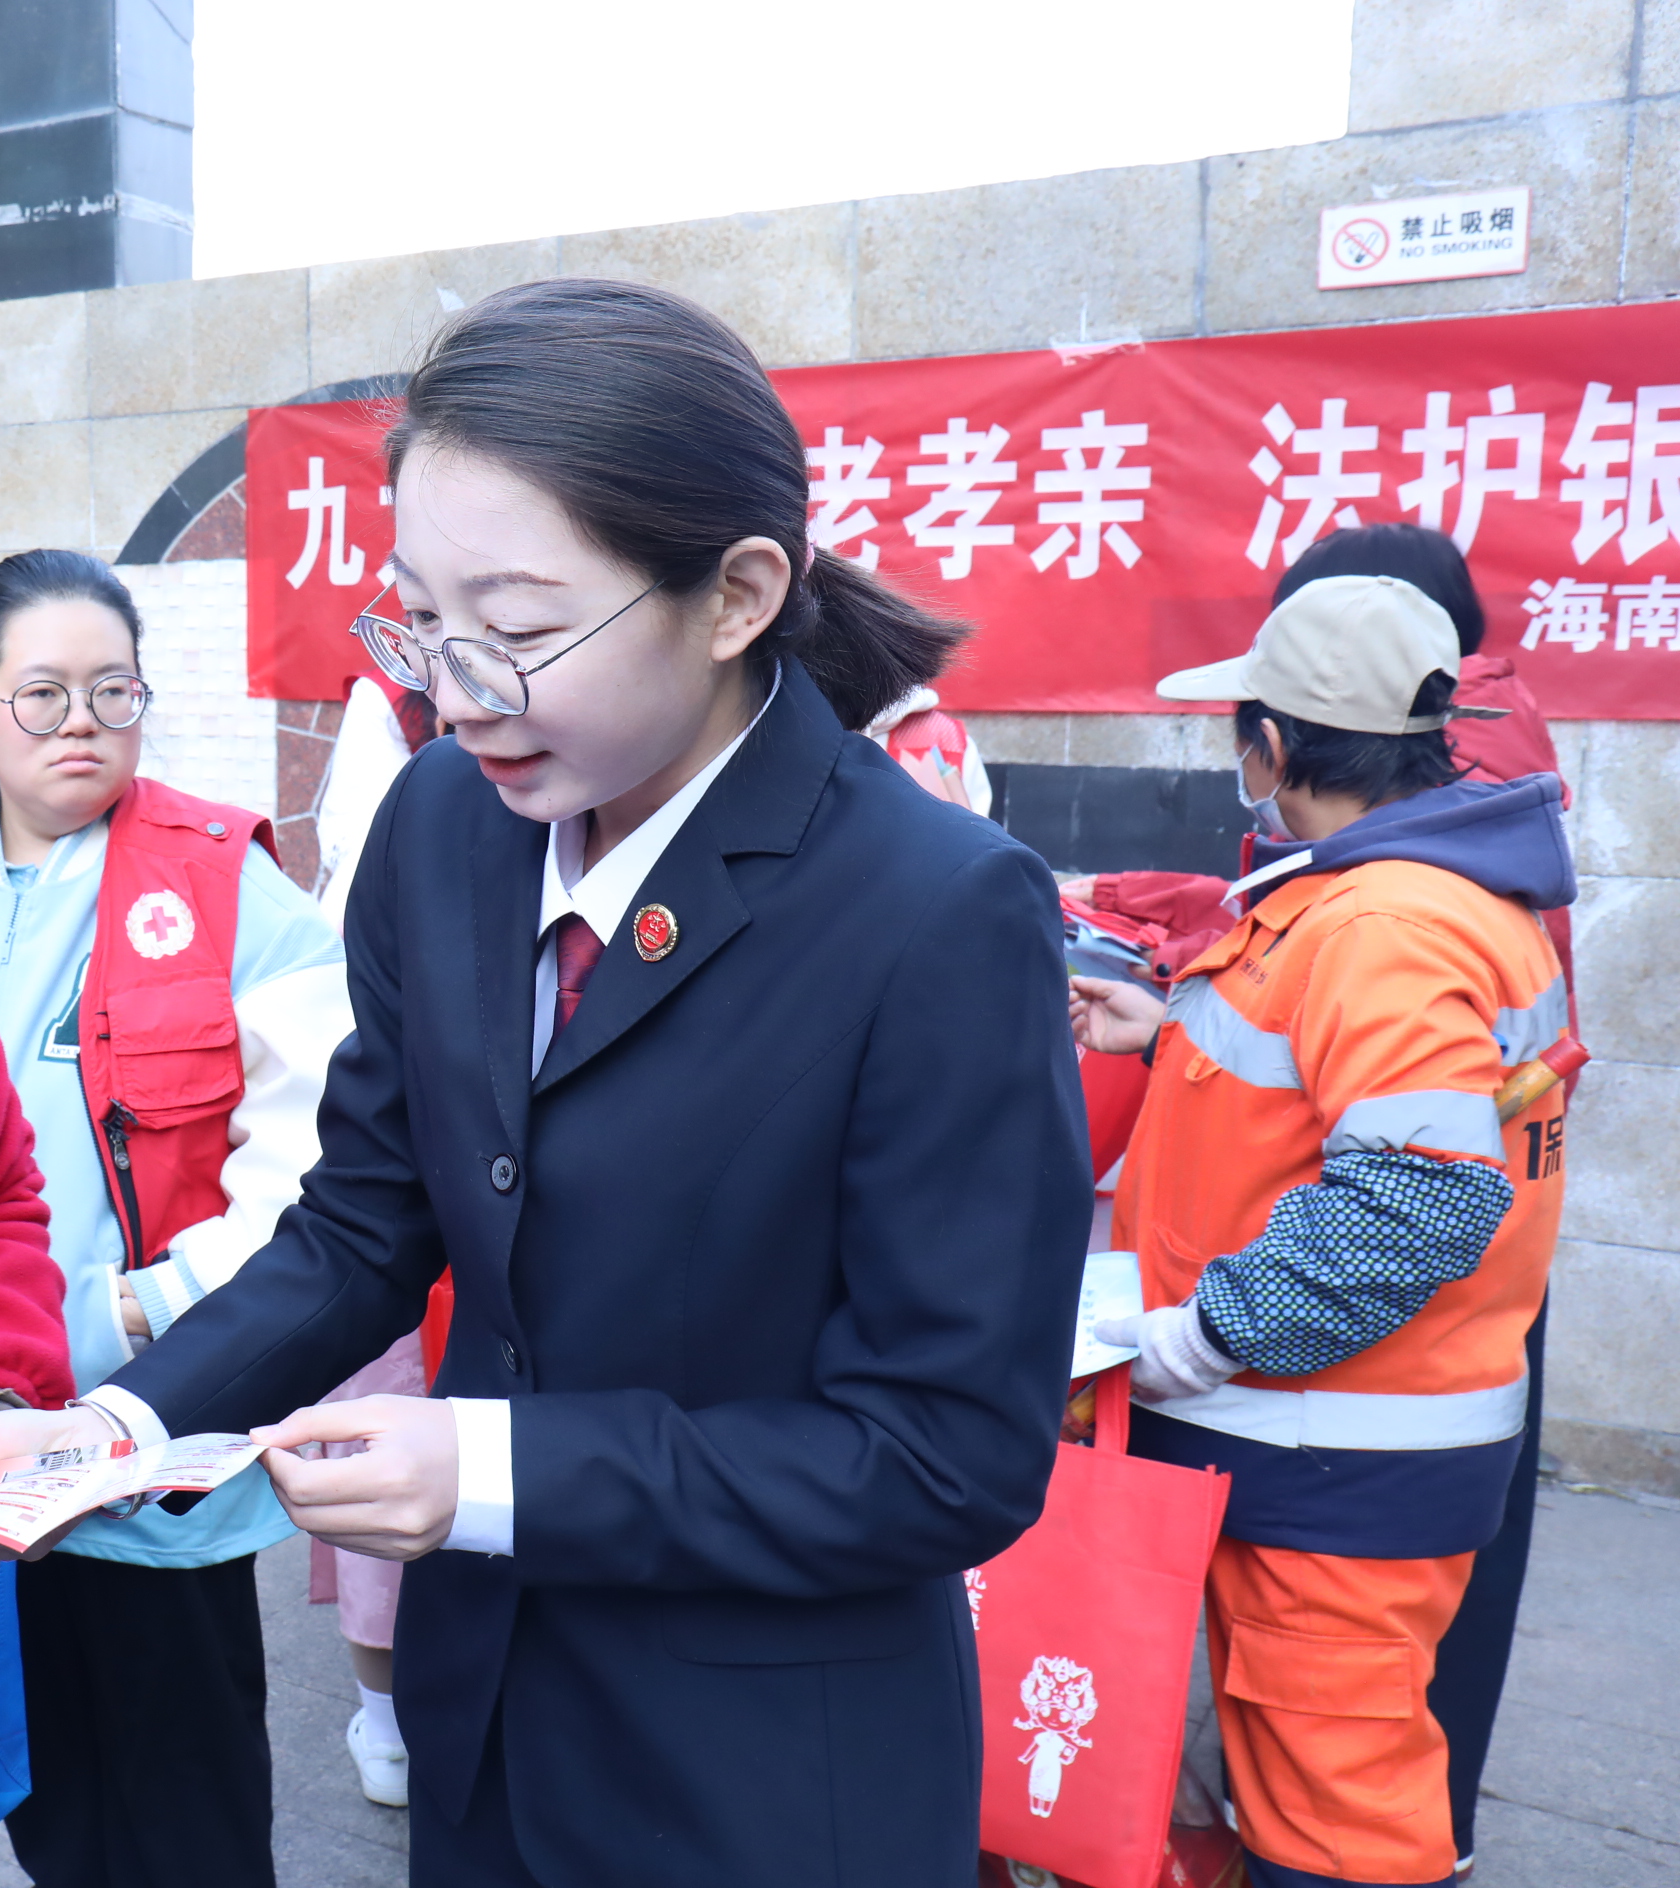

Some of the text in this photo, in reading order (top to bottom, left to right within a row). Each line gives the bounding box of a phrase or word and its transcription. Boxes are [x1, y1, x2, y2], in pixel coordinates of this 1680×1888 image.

[1400, 238, 1513, 258] NO SMOKING
[1401, 207, 1514, 241] 禁止吸烟
[1245, 381, 1680, 571] 法护银
[1520, 575, 1680, 653] 海南
